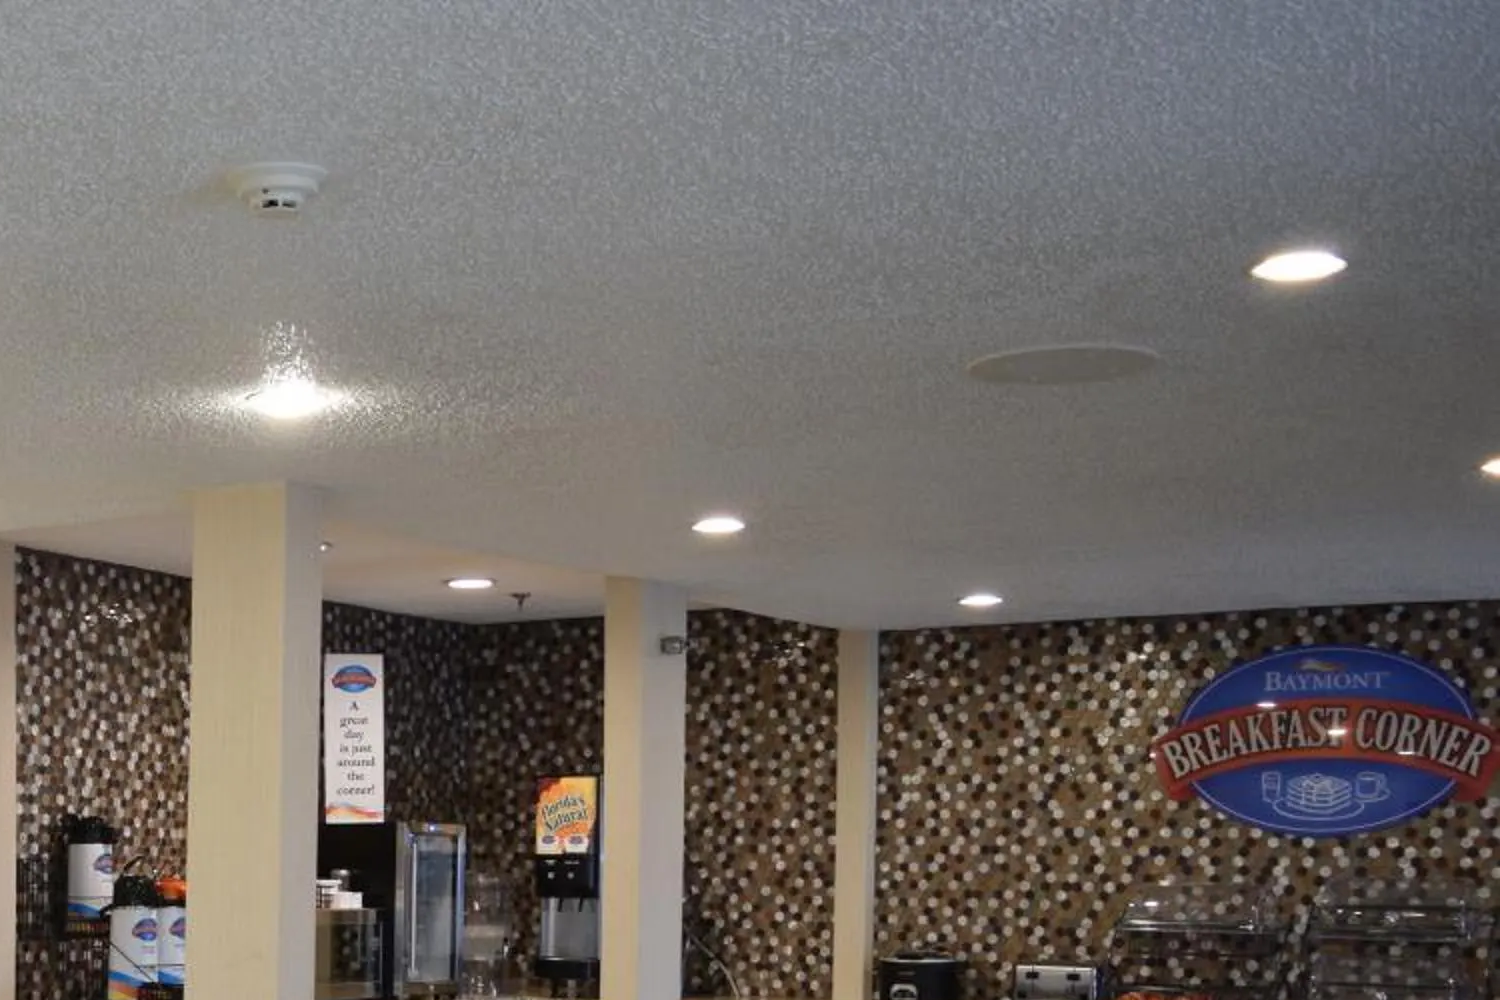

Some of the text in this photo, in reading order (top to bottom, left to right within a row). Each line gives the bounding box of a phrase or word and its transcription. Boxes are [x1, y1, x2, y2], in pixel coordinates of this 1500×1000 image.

[1263, 671, 1389, 691] BAYMONT
[349, 701, 359, 711] A
[339, 717, 369, 728] great
[344, 729, 364, 742] day
[1161, 707, 1492, 780] BREAKFAST CORNER
[339, 744, 372, 756] is just
[337, 756, 375, 766] around
[347, 771, 364, 781] the
[336, 784, 375, 795] corner!
